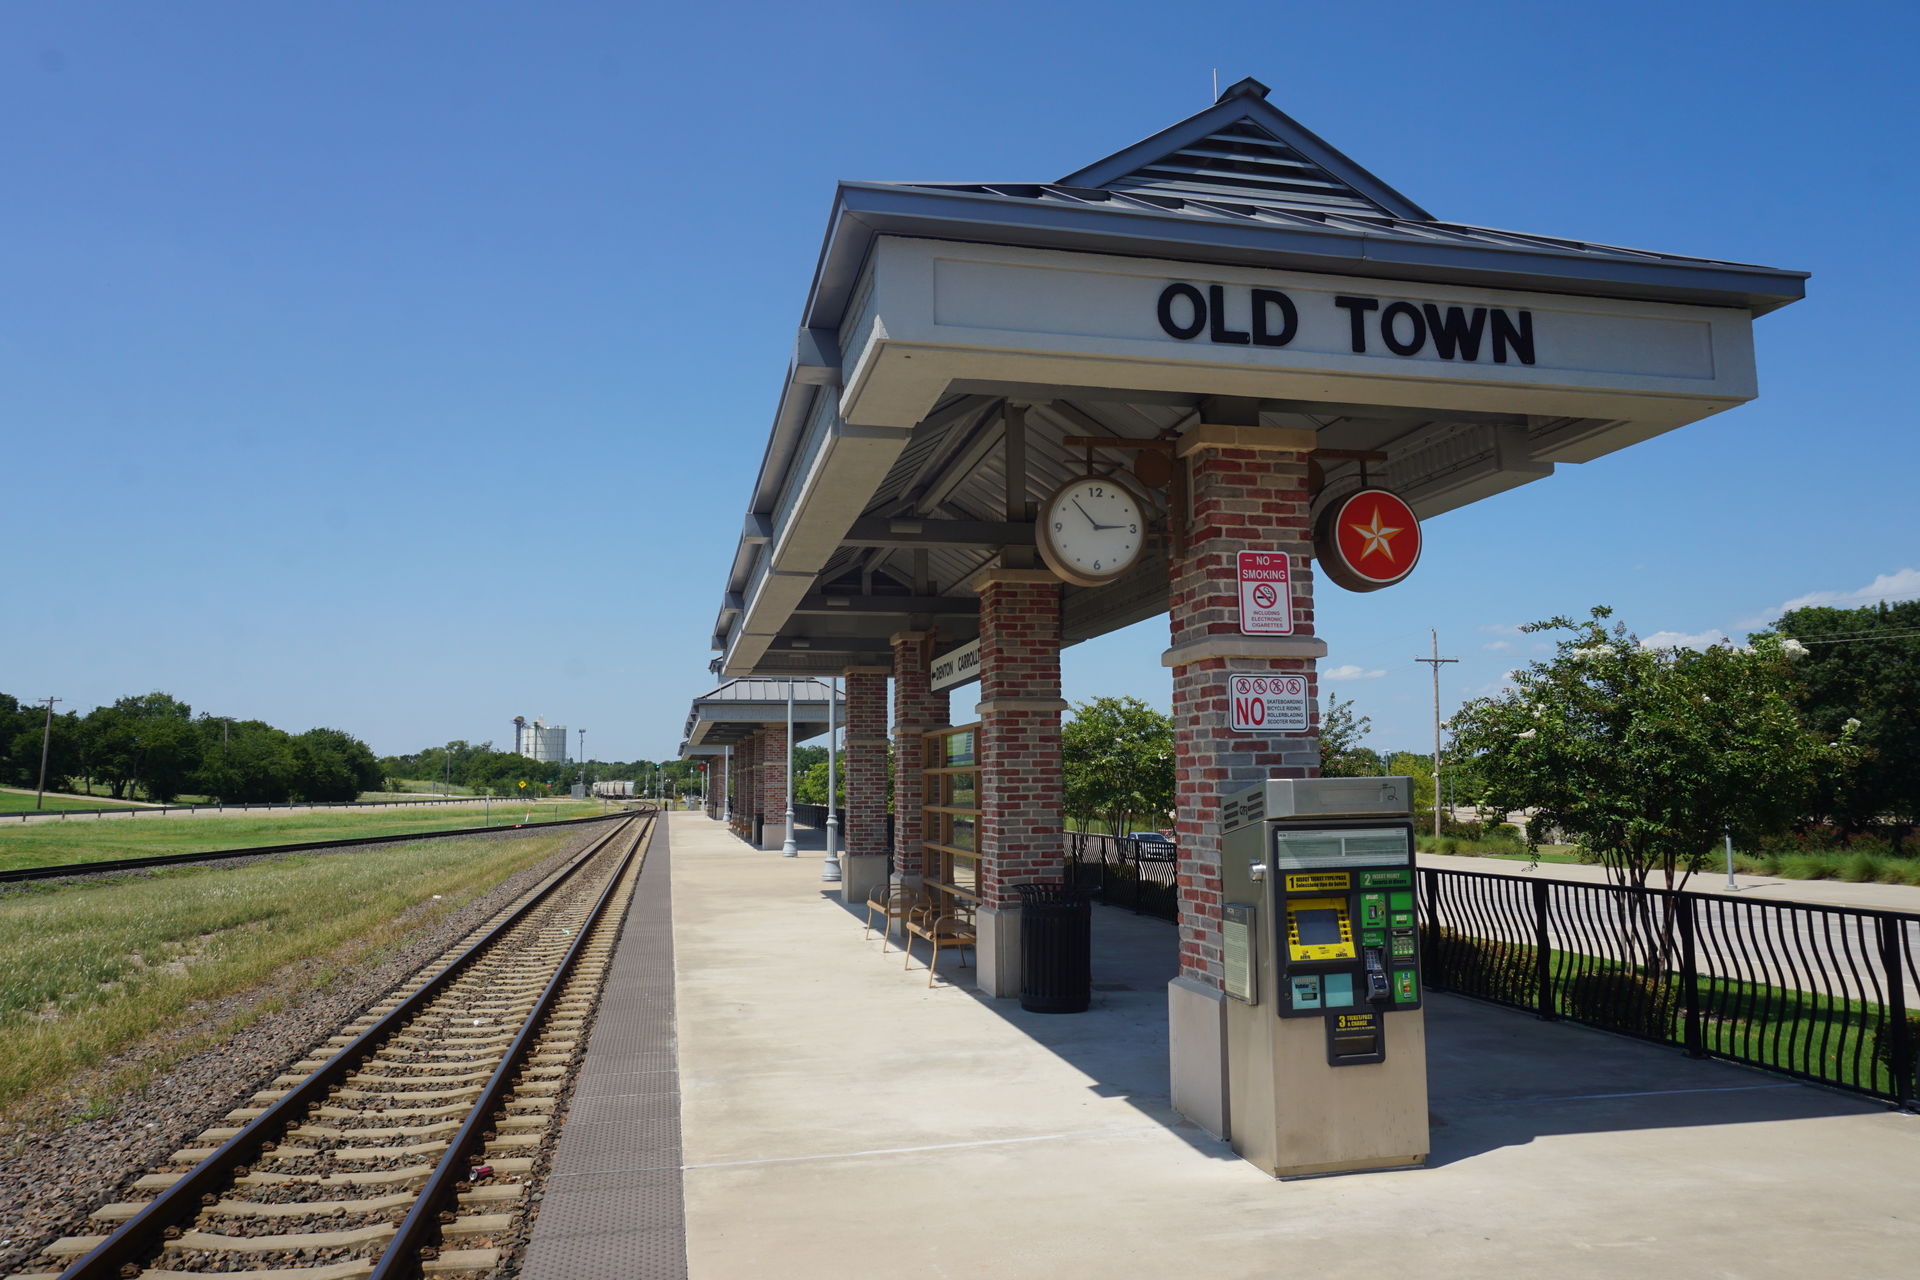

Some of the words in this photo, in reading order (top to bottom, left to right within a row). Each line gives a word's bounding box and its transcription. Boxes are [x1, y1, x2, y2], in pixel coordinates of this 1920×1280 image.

[1157, 282, 1298, 347] OLD
[1335, 296, 1536, 365] TOWN
[1088, 487, 1103, 498] 12
[1055, 522, 1063, 533] 9
[1129, 523, 1137, 534] 3
[1093, 560, 1101, 570] 6
[1256, 556, 1270, 566] NO
[1242, 569, 1286, 580] SMOKING
[936, 660, 953, 680] DENTON
[1236, 697, 1265, 726] NO
[1289, 876, 1294, 888] 1
[1364, 873, 1371, 886] 2
[1338, 1015, 1346, 1028] 3
